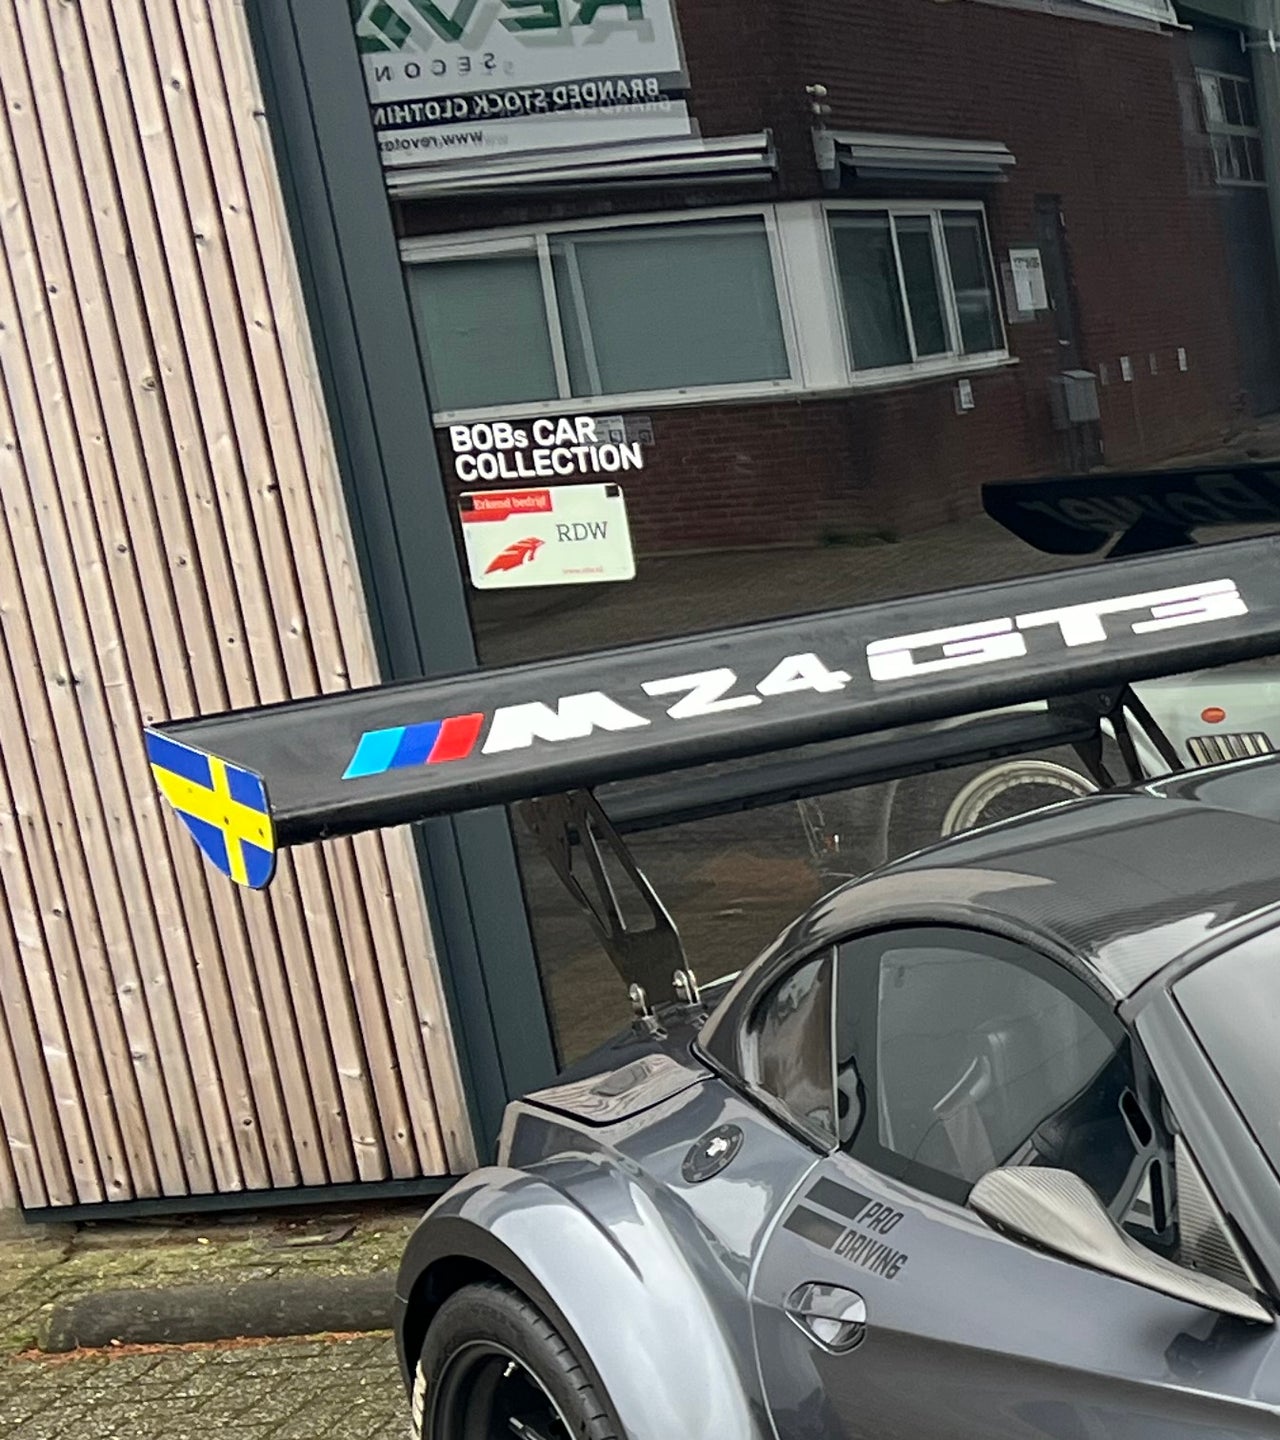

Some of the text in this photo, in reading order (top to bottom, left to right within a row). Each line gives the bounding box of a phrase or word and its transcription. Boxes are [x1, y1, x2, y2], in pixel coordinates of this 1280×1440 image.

[449, 422, 529, 452] BOBs
[532, 416, 598, 446] CAR
[454, 442, 643, 482] COLLECTION
[556, 521, 608, 543] RDW
[481, 691, 651, 755] M
[866, 578, 1250, 682] GT3
[857, 1201, 904, 1235] PRO
[834, 1229, 908, 1280] DRIVING
